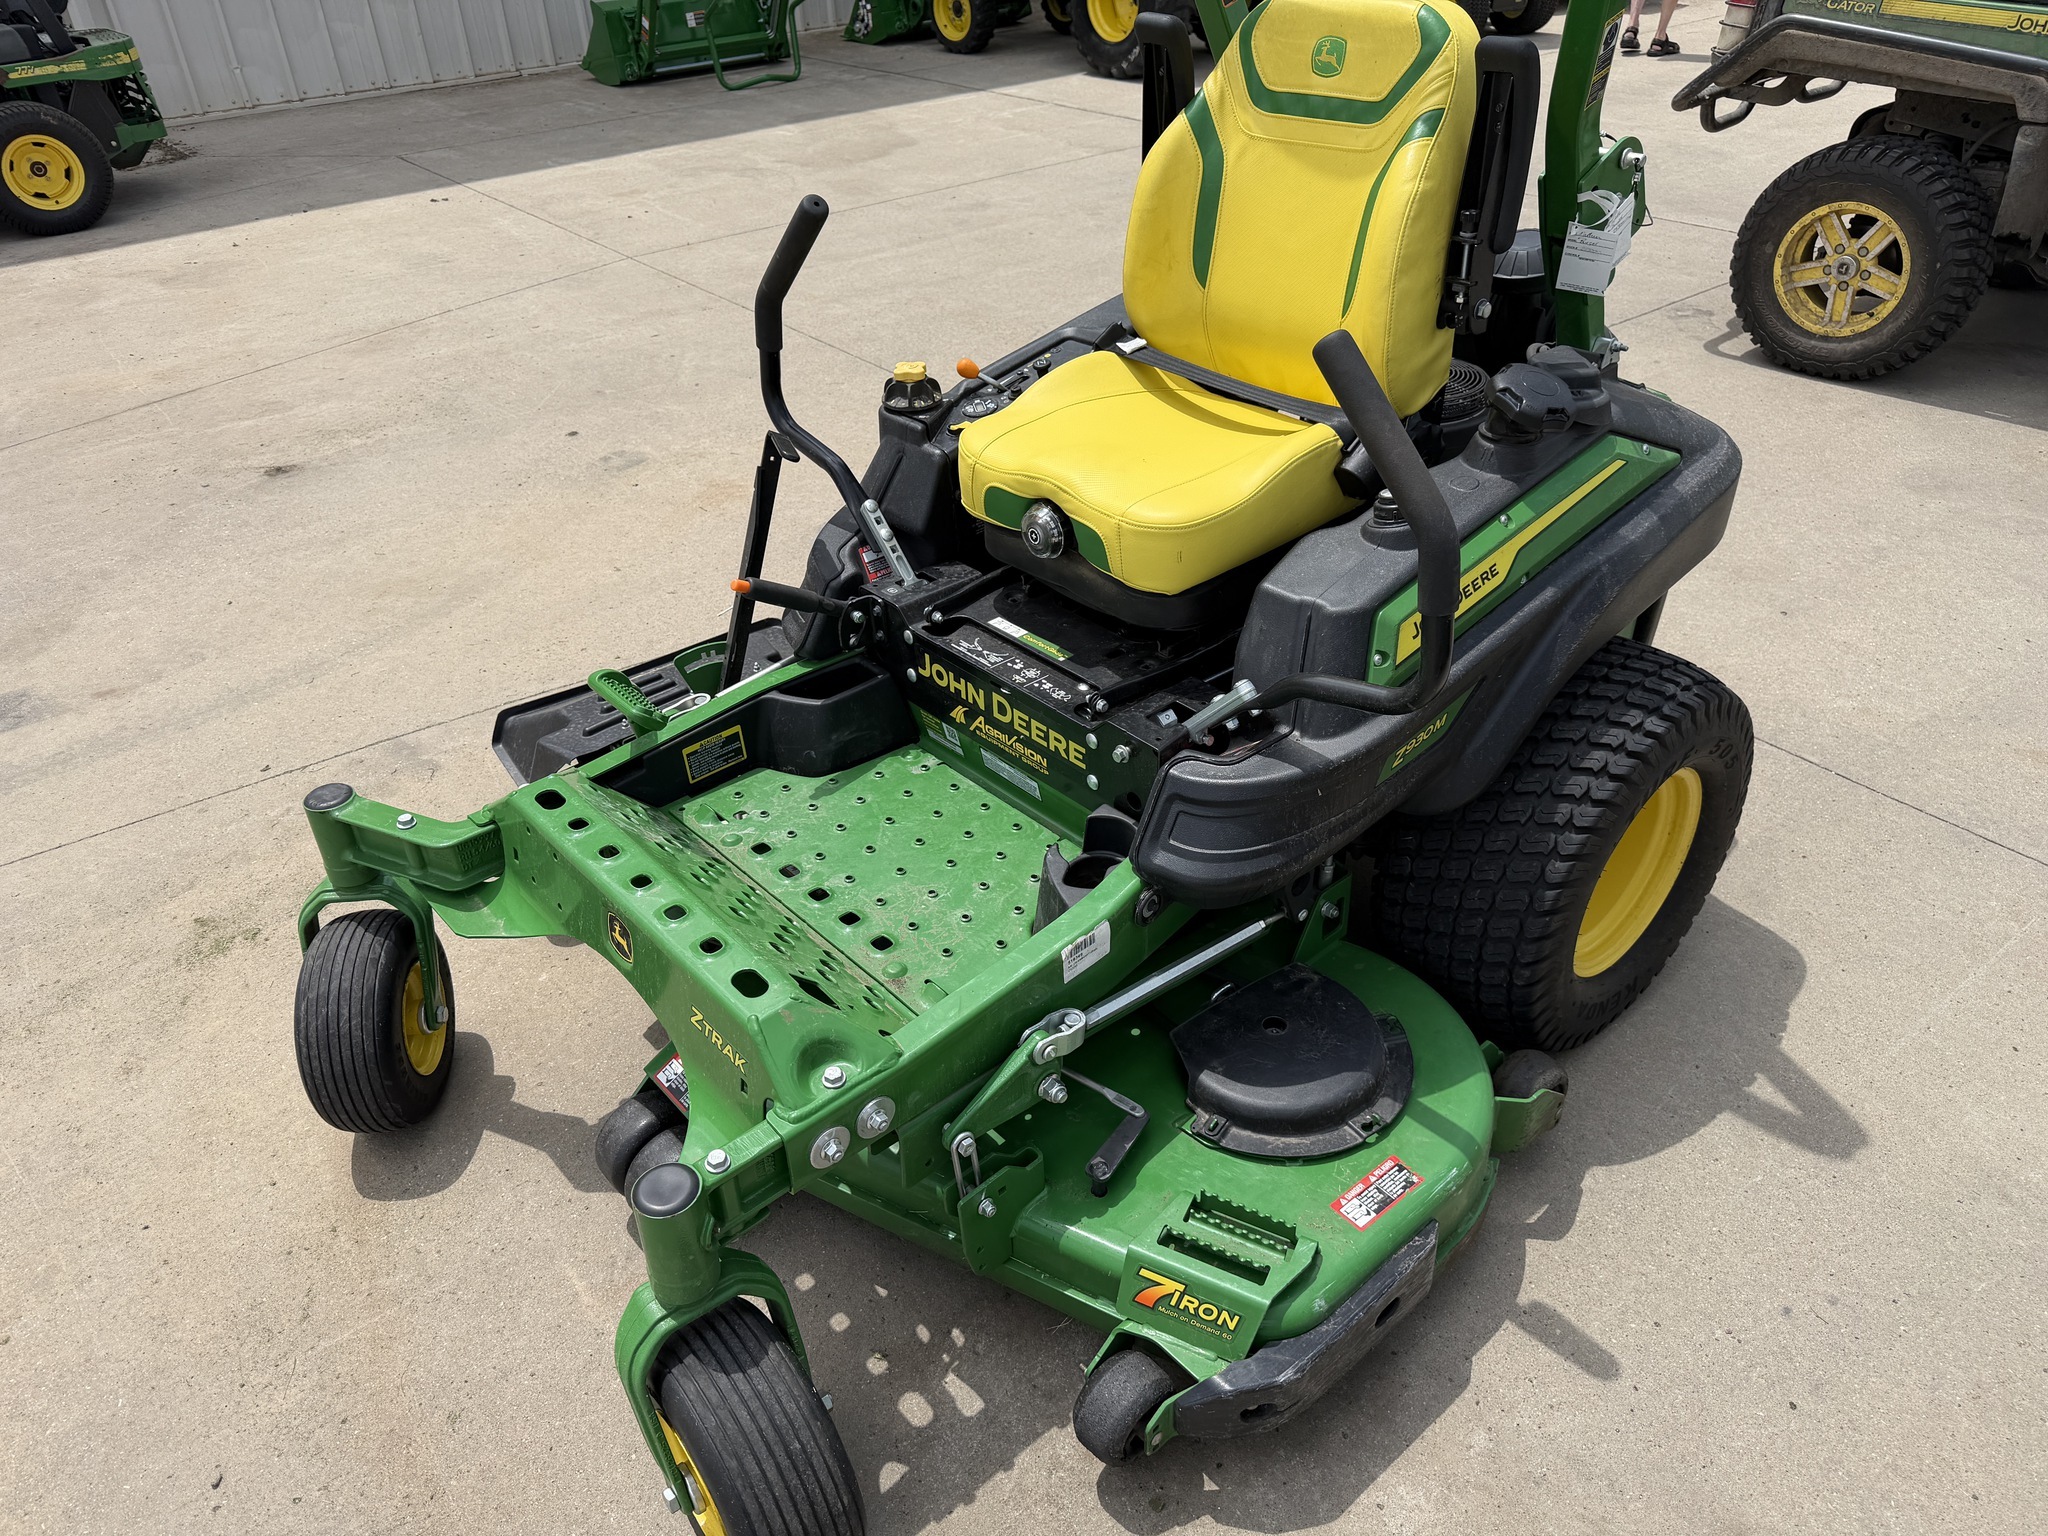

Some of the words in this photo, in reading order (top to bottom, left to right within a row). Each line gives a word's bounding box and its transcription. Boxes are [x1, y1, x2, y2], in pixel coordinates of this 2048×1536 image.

[1826, 0, 1876, 14] GATOR
[2007, 14, 2048, 32] JOH
[918, 653, 986, 711] JOHN
[992, 692, 1087, 770] DEERE
[975, 730, 1020, 758] EQUIPMENT
[1021, 756, 1050, 775] GROUP
[1392, 713, 1448, 769] Z930M
[690, 1005, 749, 1074] ZTRAK
[1158, 1306, 1179, 1318] Mulch
[1179, 1315, 1189, 1323] on
[1190, 1319, 1220, 1336] Demand
[1222, 1332, 1233, 1341] 60
